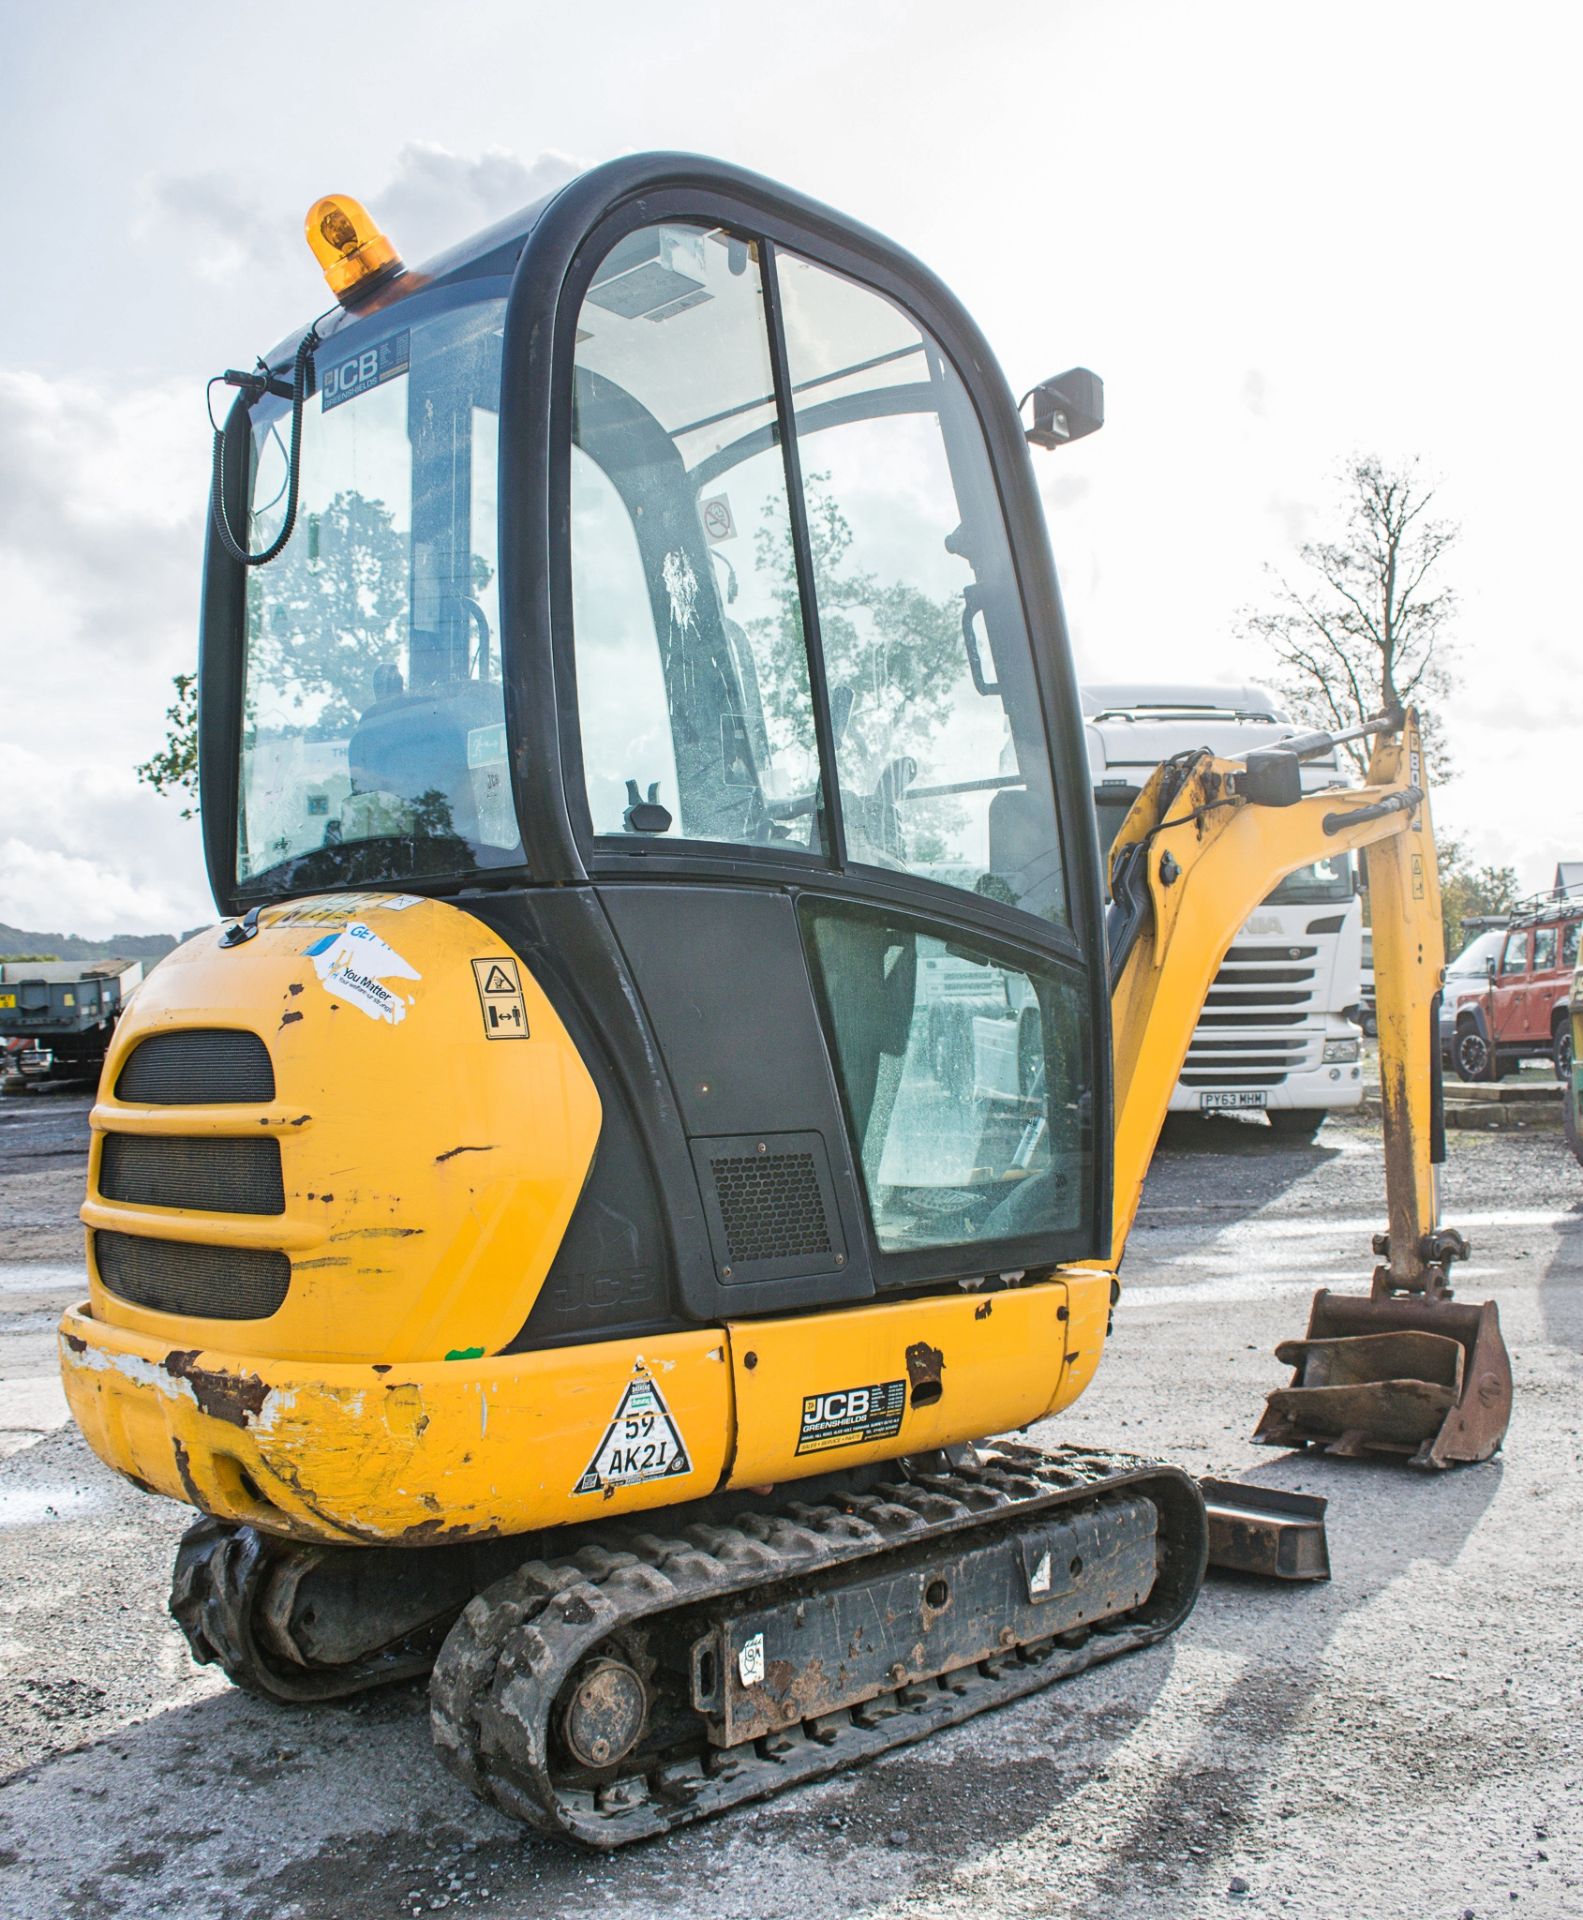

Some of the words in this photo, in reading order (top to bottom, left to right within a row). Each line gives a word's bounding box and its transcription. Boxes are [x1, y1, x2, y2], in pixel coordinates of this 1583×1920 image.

[324, 349, 378, 398] JCB
[343, 968, 360, 983] You
[360, 977, 392, 1001] Matter
[1206, 1094, 1236, 1105] PY63
[1239, 1093, 1262, 1105] MHM
[804, 1389, 869, 1424] JCB
[625, 1410, 655, 1439] 59
[802, 1414, 867, 1433] GREENSHIELDS
